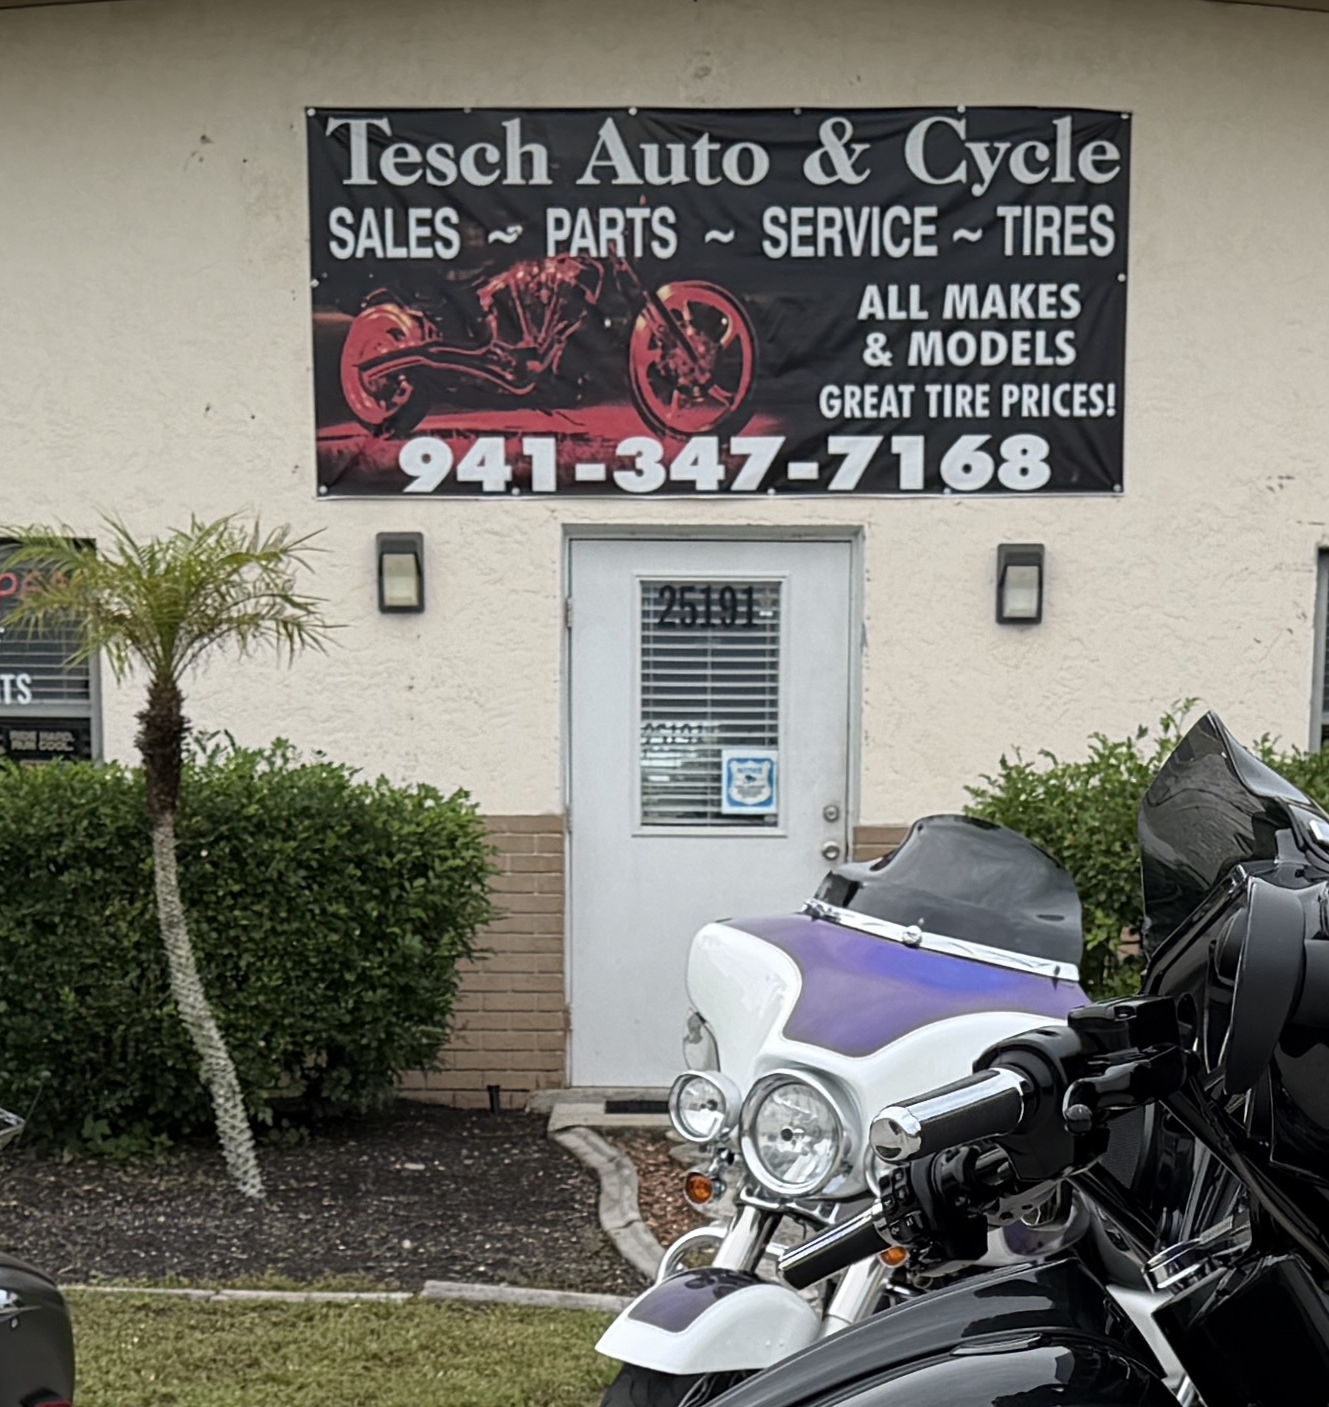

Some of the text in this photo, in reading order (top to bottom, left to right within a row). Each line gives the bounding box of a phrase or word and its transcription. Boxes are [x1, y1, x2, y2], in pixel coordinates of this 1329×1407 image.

[327, 115, 1122, 196] Tesch Auto & Cycle
[329, 206, 460, 259] SALES
[547, 206, 677, 258] PARTS
[762, 206, 938, 258] SERVICE
[997, 205, 1115, 257] TIRES
[858, 284, 1081, 320] ALL MAKES
[863, 331, 1076, 367] & MODELS
[820, 384, 1115, 419] GREAT TIRE PRICES!
[398, 434, 1051, 492] 941-347-7168
[657, 584, 758, 629] 25191
